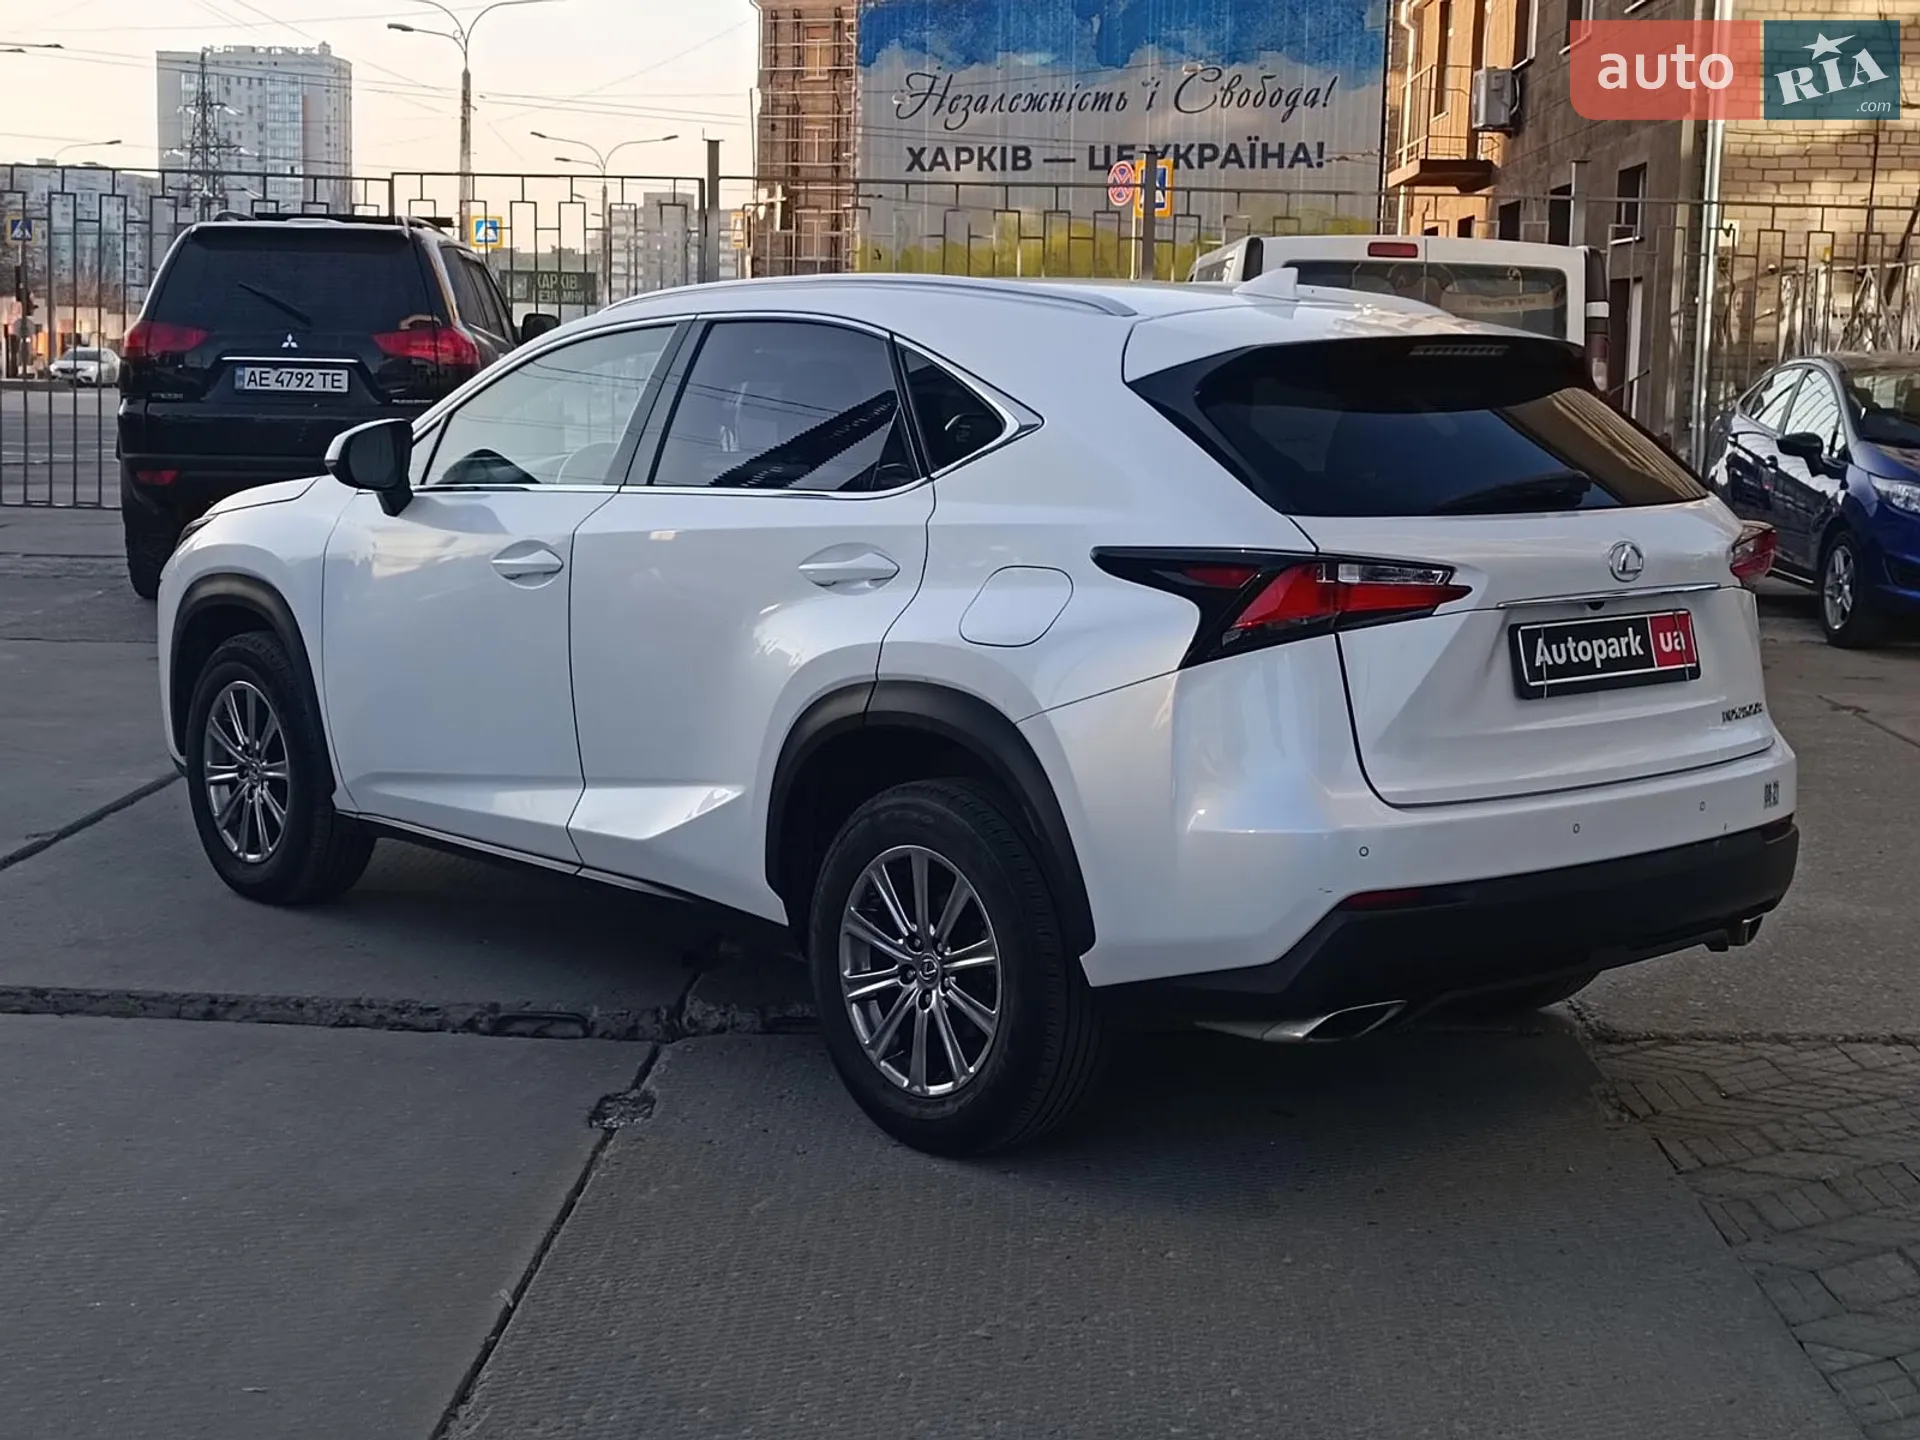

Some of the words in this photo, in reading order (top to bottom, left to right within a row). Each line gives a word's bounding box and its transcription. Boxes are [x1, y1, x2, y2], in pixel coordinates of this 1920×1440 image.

[896, 72, 1129, 131] Незалежність
[1174, 67, 1338, 124] Свобода!
[904, 145, 1033, 172] ХАРКІВ
[246, 370, 271, 388] AE
[275, 370, 314, 388] 4792
[320, 372, 343, 389] TE
[1535, 626, 1645, 669] Autopark
[1659, 630, 1687, 654] ua
